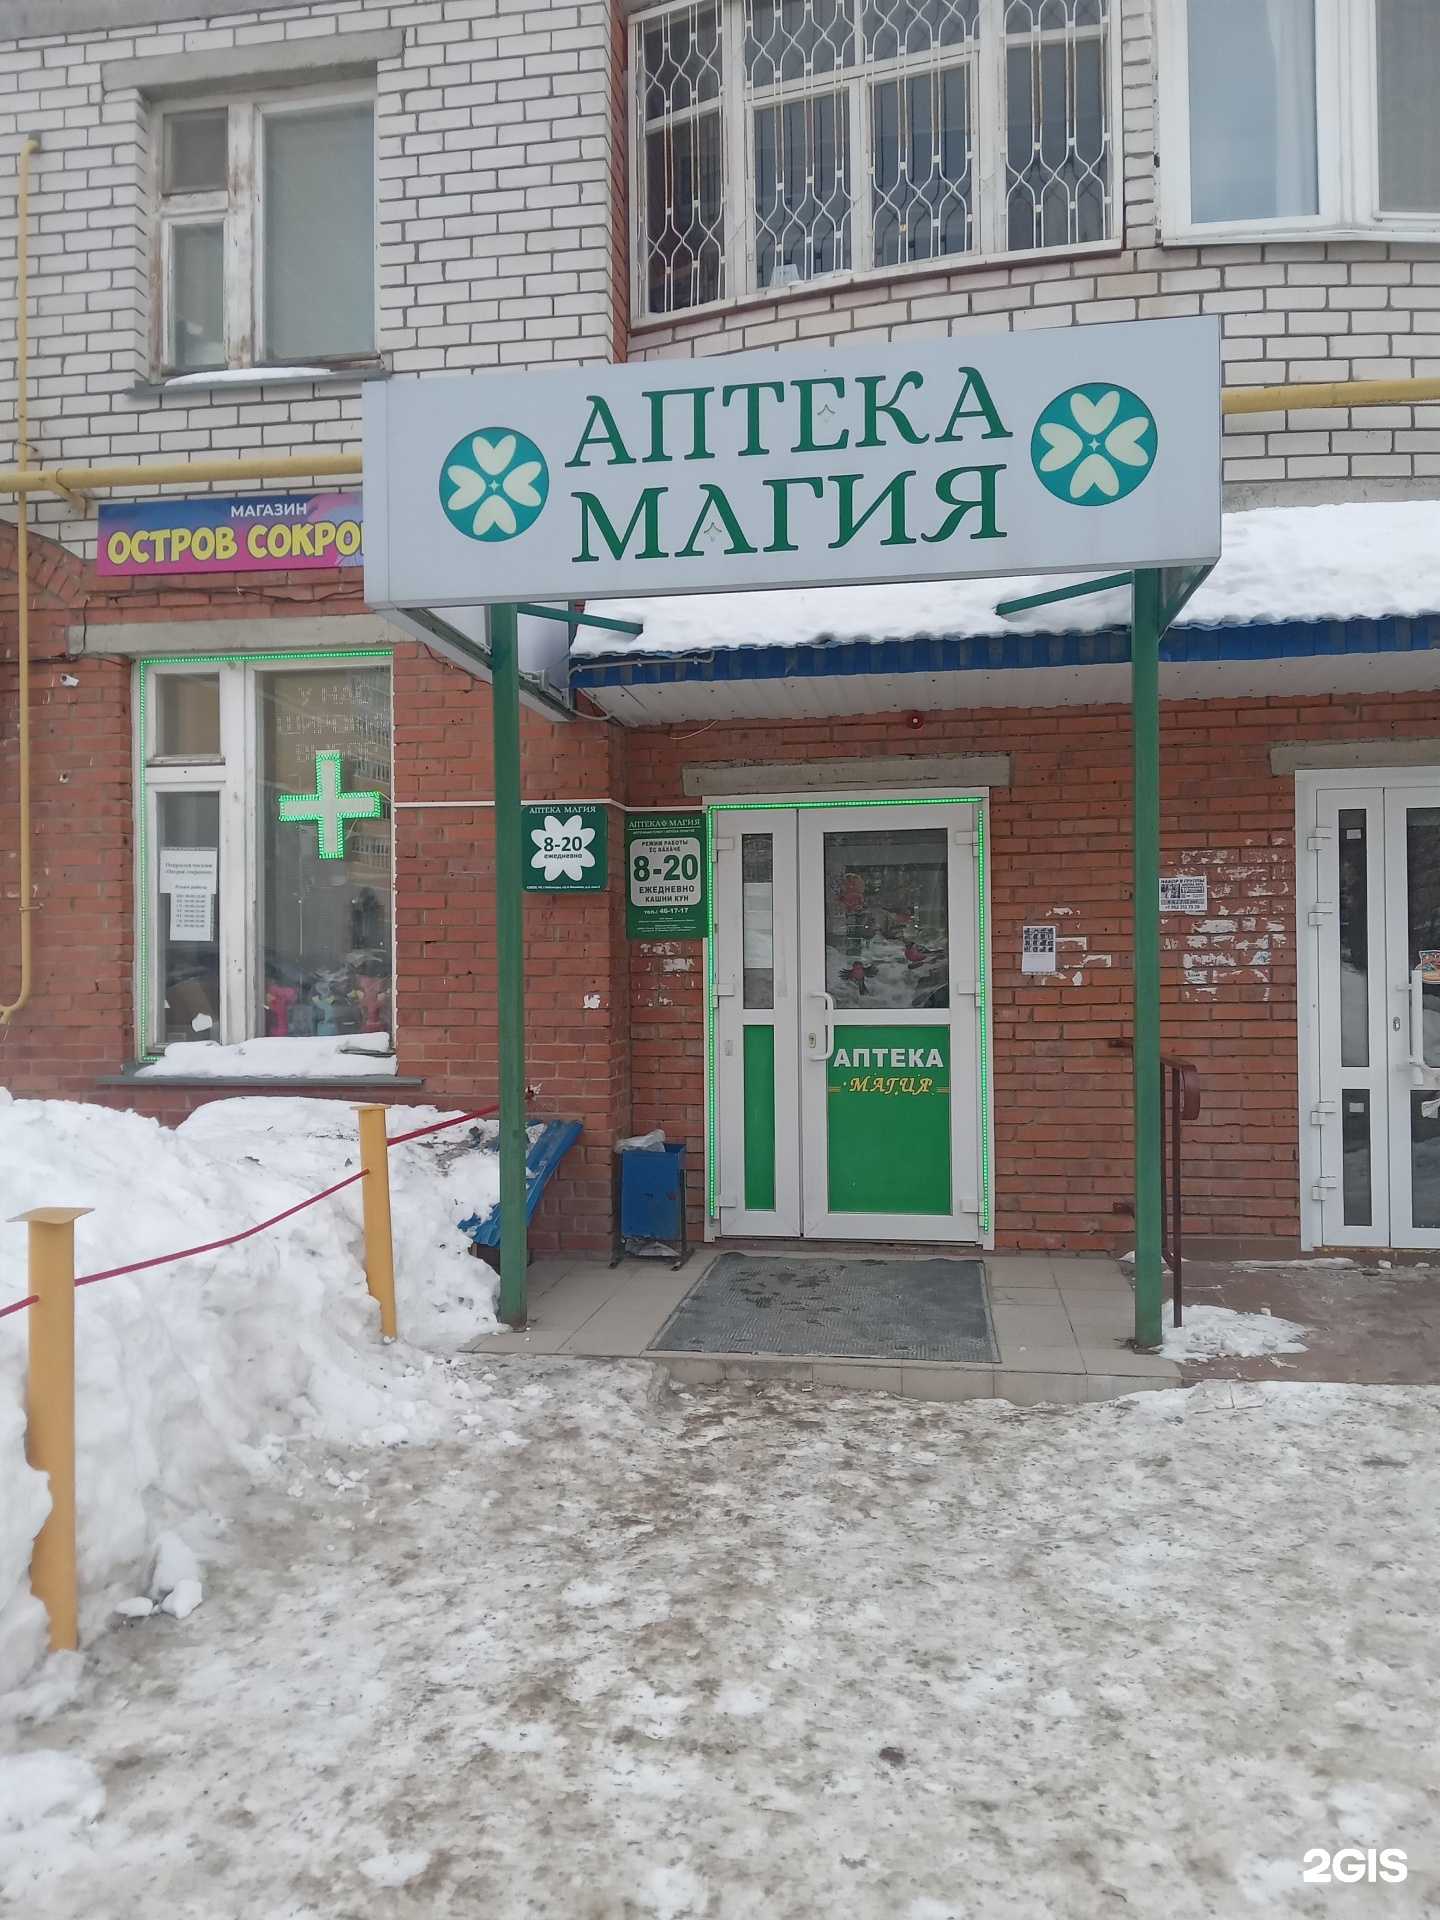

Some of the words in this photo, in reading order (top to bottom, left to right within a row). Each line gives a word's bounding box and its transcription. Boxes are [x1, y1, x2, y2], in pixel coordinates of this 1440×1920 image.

[565, 366, 1013, 468] АПТЕКА
[230, 502, 307, 518] МАГАЗИН
[570, 463, 1008, 563] МАГИЯ
[107, 525, 239, 566] ОСТРОВ
[247, 520, 364, 560] СОКРО
[529, 806, 561, 814] АПТЕКА
[629, 820, 661, 828] АПТЕКА
[669, 818, 700, 827] МАГИЯ
[543, 836, 583, 852] 8-20
[633, 854, 698, 882] 8-20
[639, 885, 695, 894] ЕЖЕДНЕВНО
[833, 1048, 944, 1068] АПТЕКА
[849, 1075, 933, 1095] МАГИЯ
